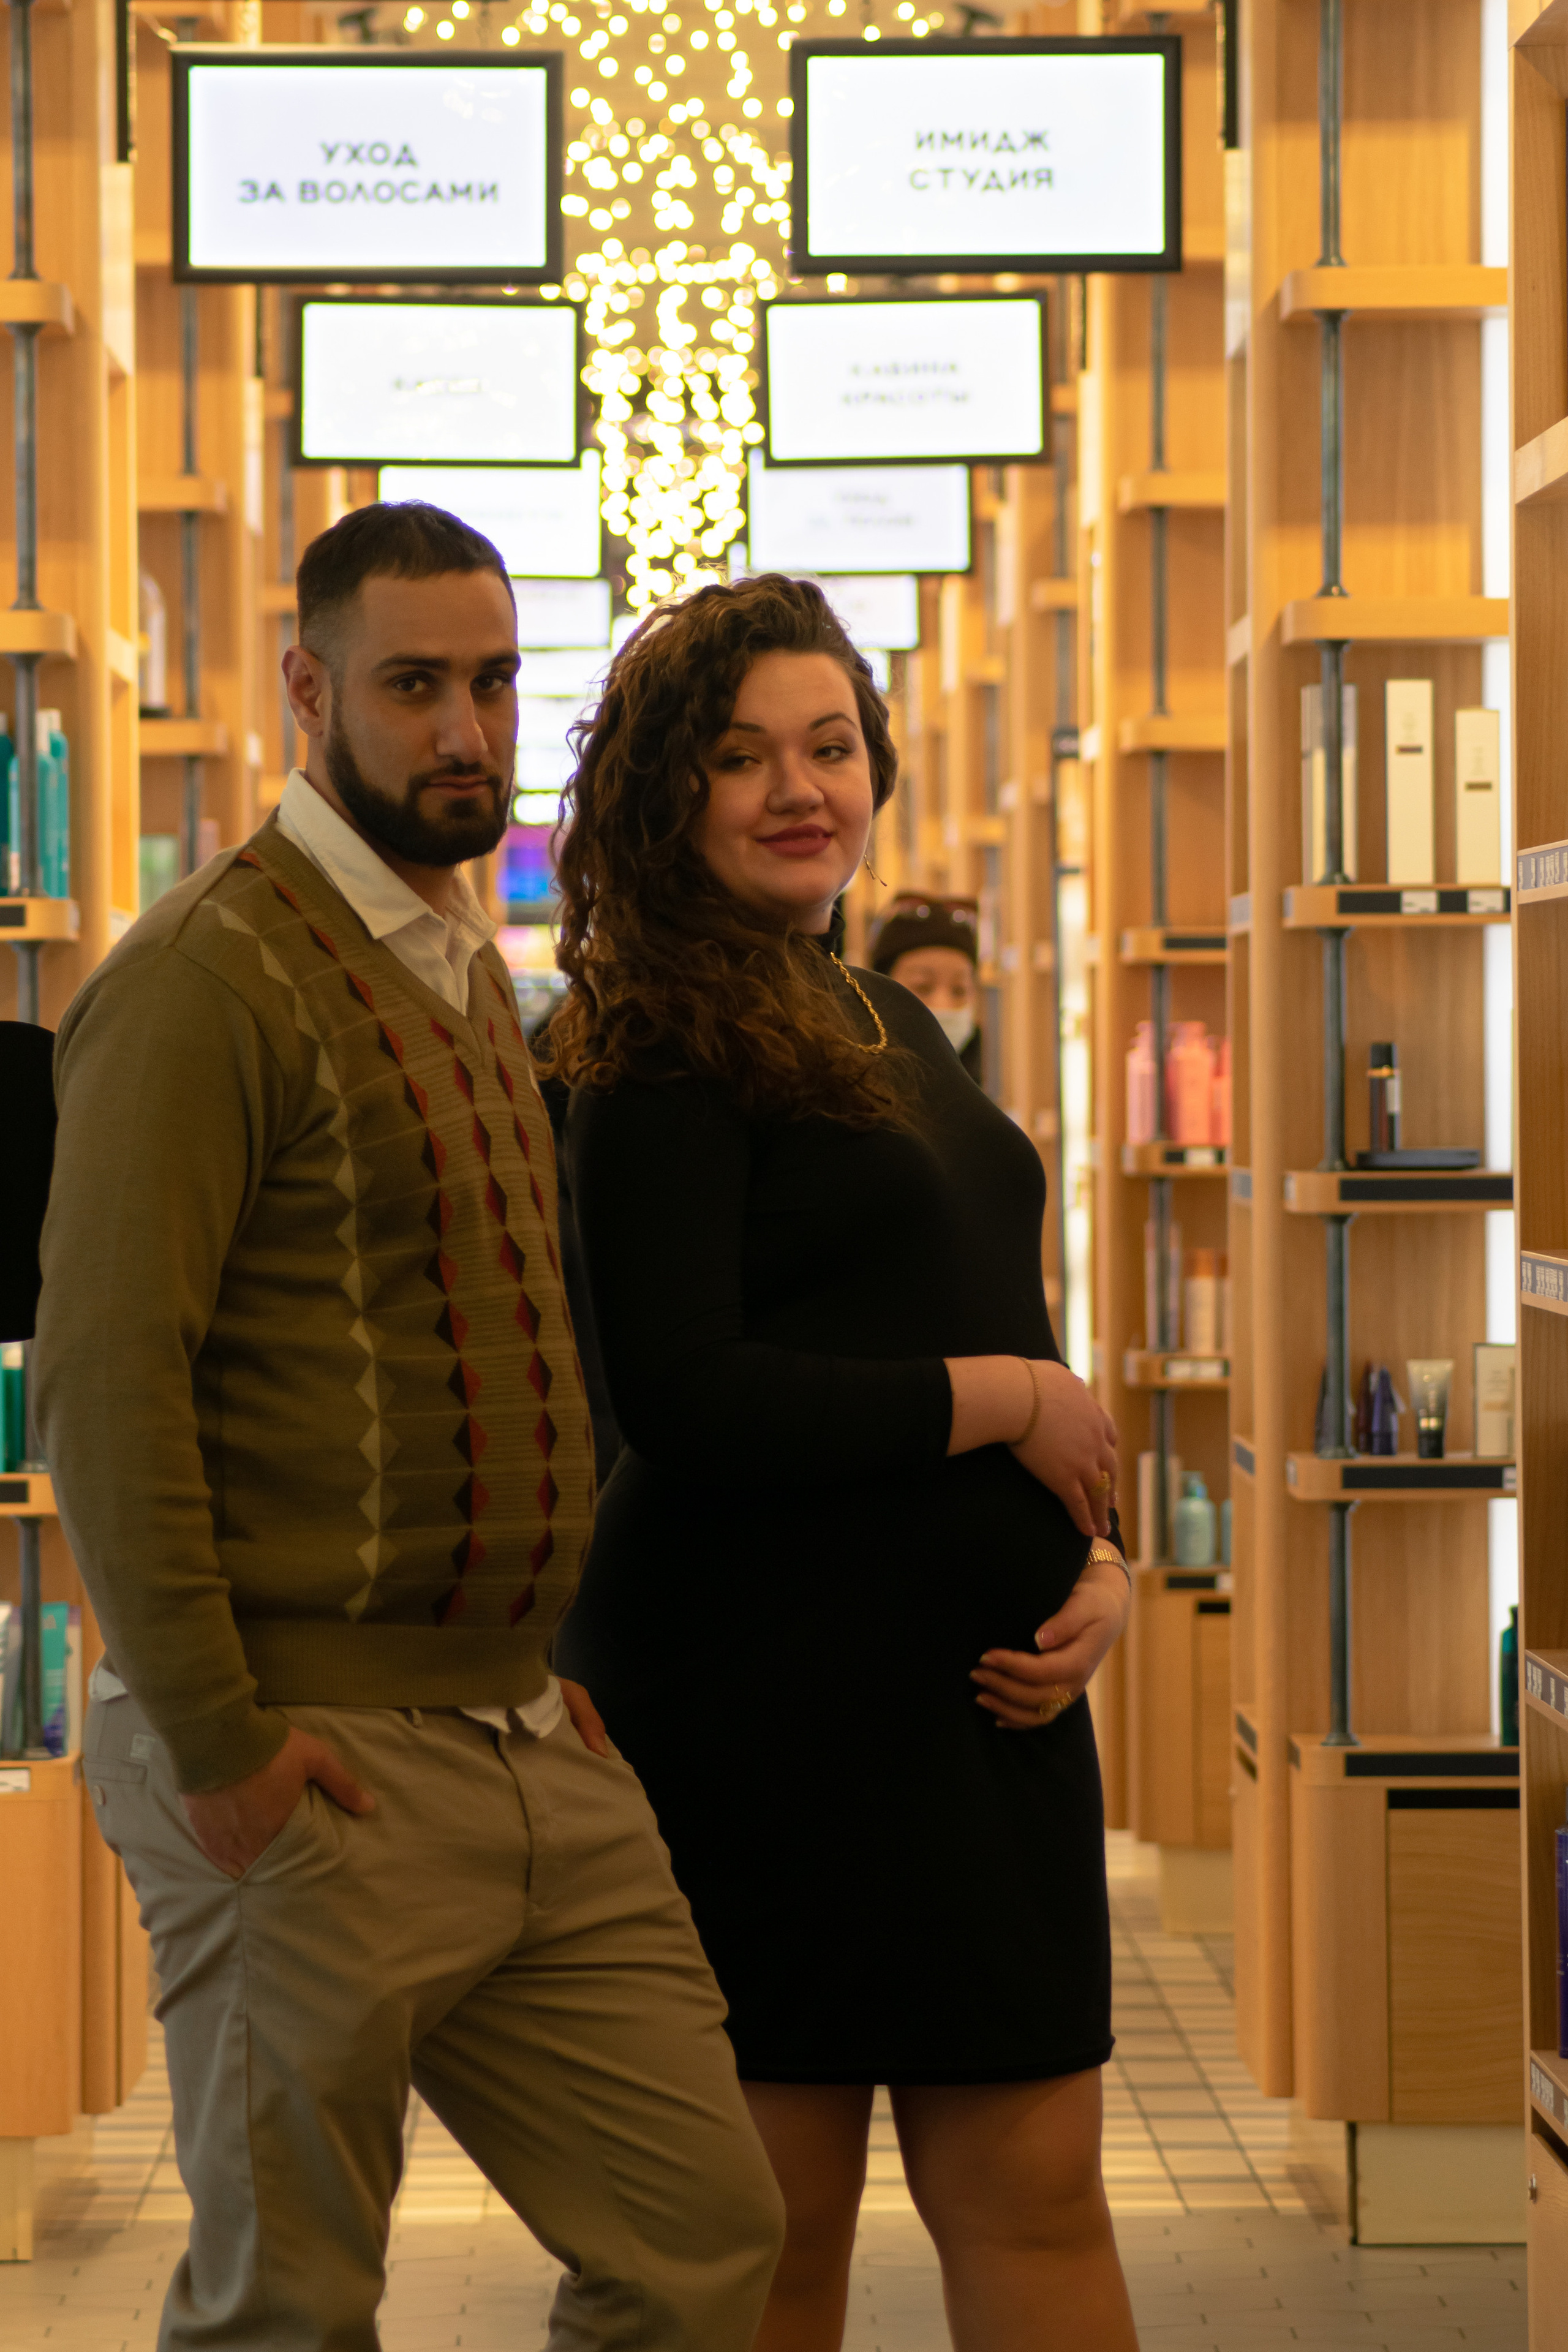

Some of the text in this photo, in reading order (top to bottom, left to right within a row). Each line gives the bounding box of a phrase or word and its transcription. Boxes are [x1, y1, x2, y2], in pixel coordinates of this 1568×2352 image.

[320, 141, 419, 167] УХОД
[915, 130, 1050, 154] ИМИДЖ
[238, 179, 499, 204] ЗА ВОЛОСАМИ
[909, 167, 1054, 193] СТУДИЯ
